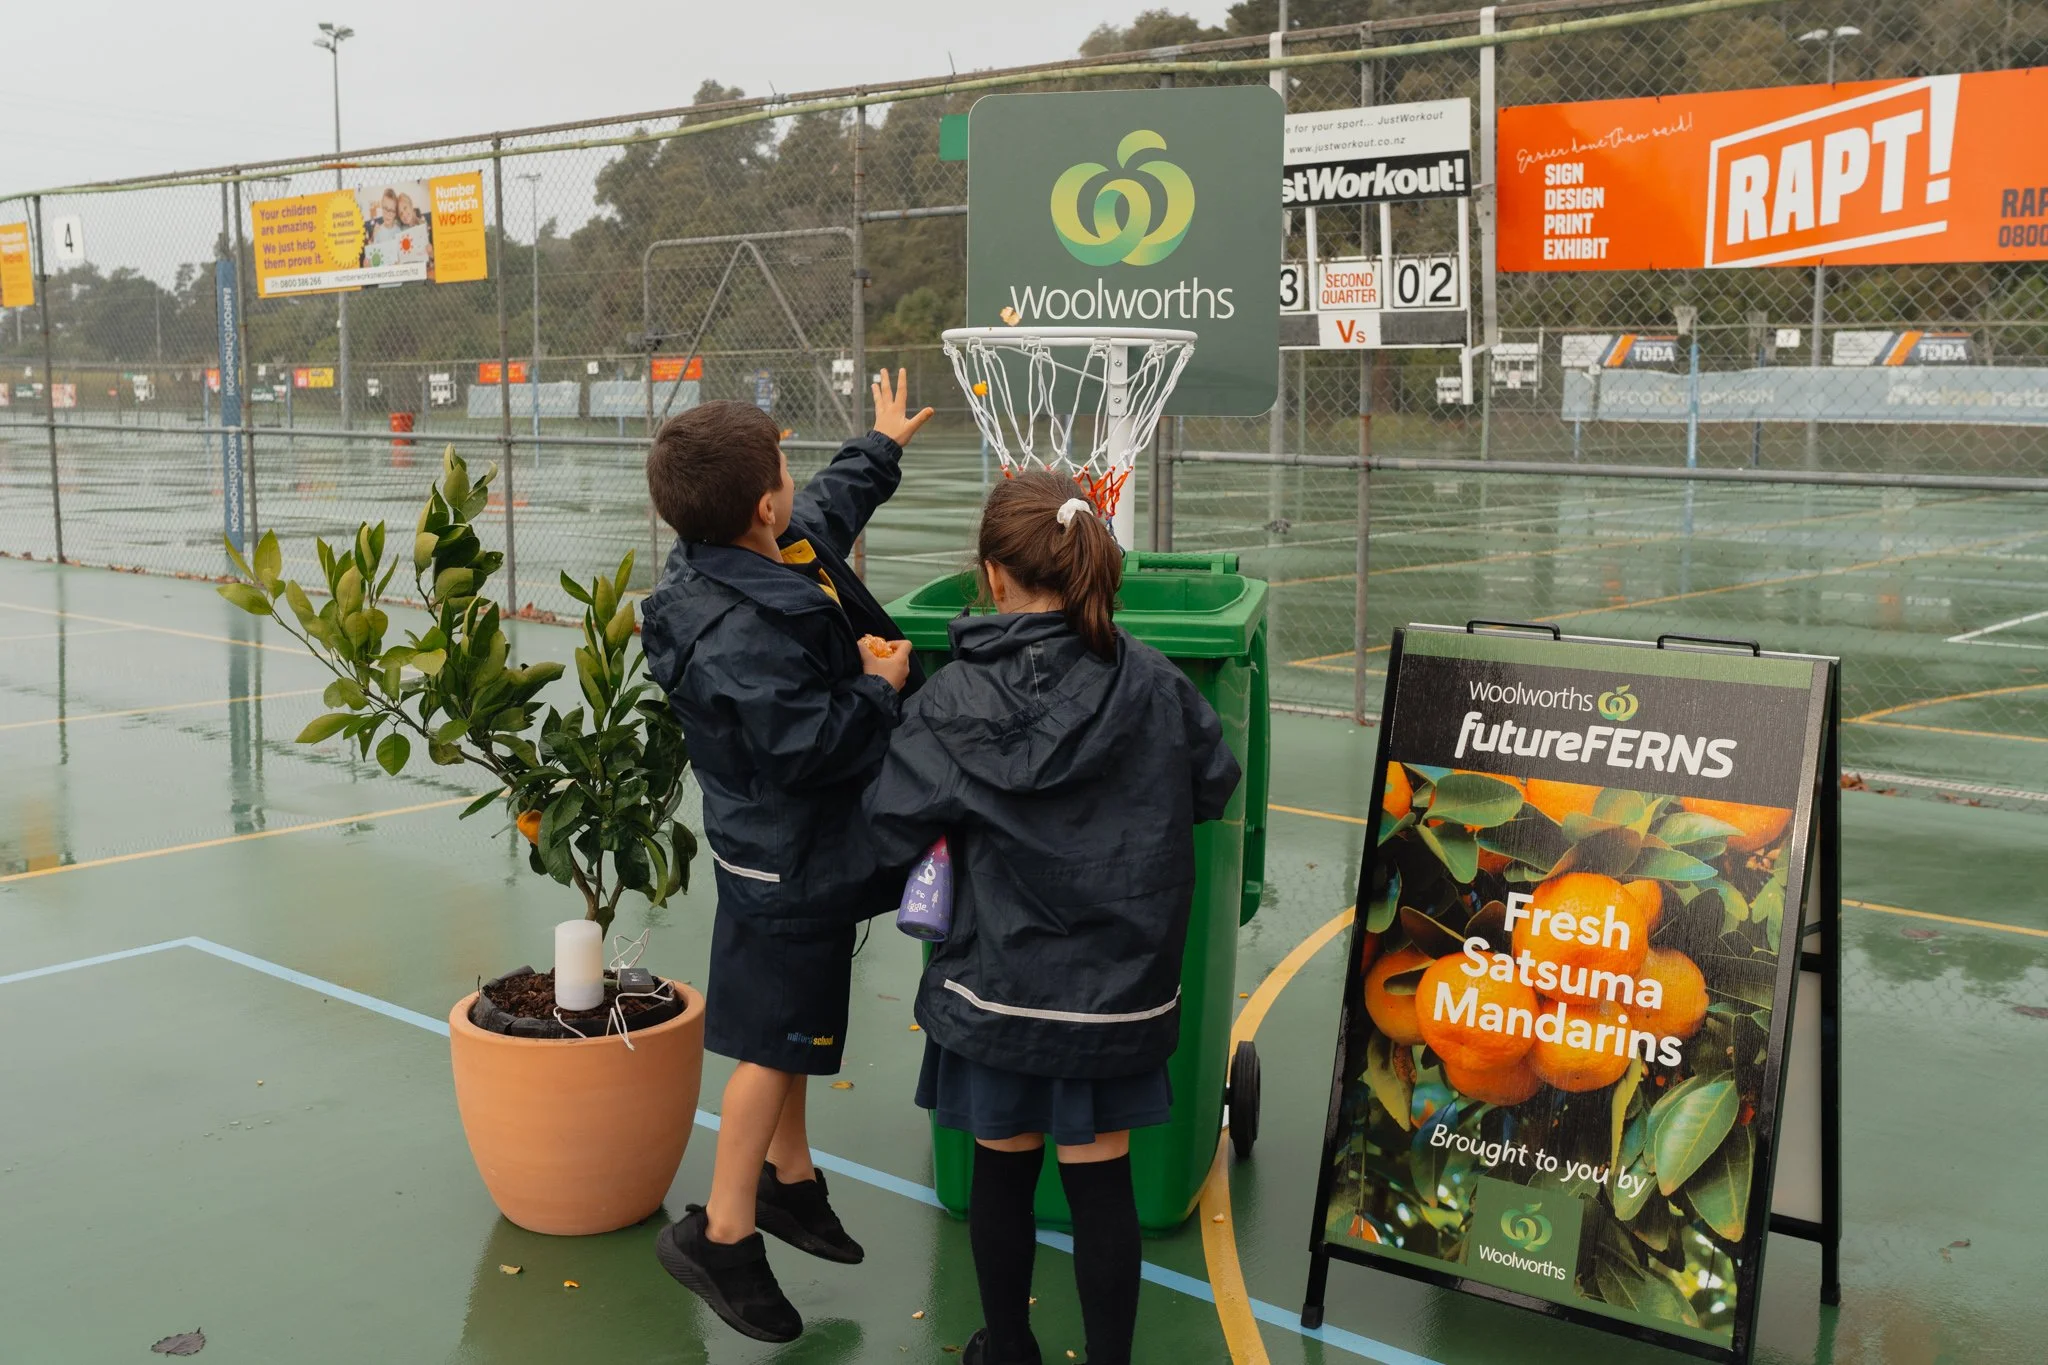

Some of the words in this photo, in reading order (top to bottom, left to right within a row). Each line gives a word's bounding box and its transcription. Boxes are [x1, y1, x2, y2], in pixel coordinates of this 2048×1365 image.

[1294, 124, 1308, 133] for
[1312, 121, 1334, 133] your
[1337, 119, 1373, 130] sport...
[1377, 111, 1444, 125] JustWorkout
[1289, 137, 1406, 154] www.justworkout.co.nz
[1516, 149, 1568, 173] Easier
[1571, 138, 1608, 153] done
[1651, 112, 1693, 137] said!
[1727, 74, 1960, 245] RAPT!
[1544, 162, 1584, 186] SIGN
[435, 183, 476, 199] Number
[1544, 187, 1605, 210] DESIGN
[260, 209, 279, 221] Your
[281, 205, 317, 218] children
[1544, 213, 1594, 235] PRINT
[261, 227, 274, 236] are
[277, 221, 317, 234] amazing.
[263, 243, 276, 254] We
[279, 241, 294, 255] just
[296, 239, 316, 252] help
[1543, 237, 1609, 260] EXHIBIT
[264, 258, 286, 270] them
[288, 257, 313, 268] prove
[1325, 272, 1373, 288] SECOND
[1010, 277, 1235, 320] Woolworths
[1322, 289, 1376, 305] QUARTER
[1469, 681, 1593, 712] Woolworths
[1454, 711, 1738, 779] futureFERNS
[1503, 891, 1630, 951] Fresh
[1460, 936, 1664, 1010] Satsuma
[1433, 981, 1683, 1067] Mandarins
[1430, 1123, 1529, 1167] Brought
[1535, 1148, 1558, 1172] to
[1560, 1160, 1609, 1185] you
[1617, 1165, 1648, 1198] by
[1478, 1244, 1566, 1281] Woolworths
